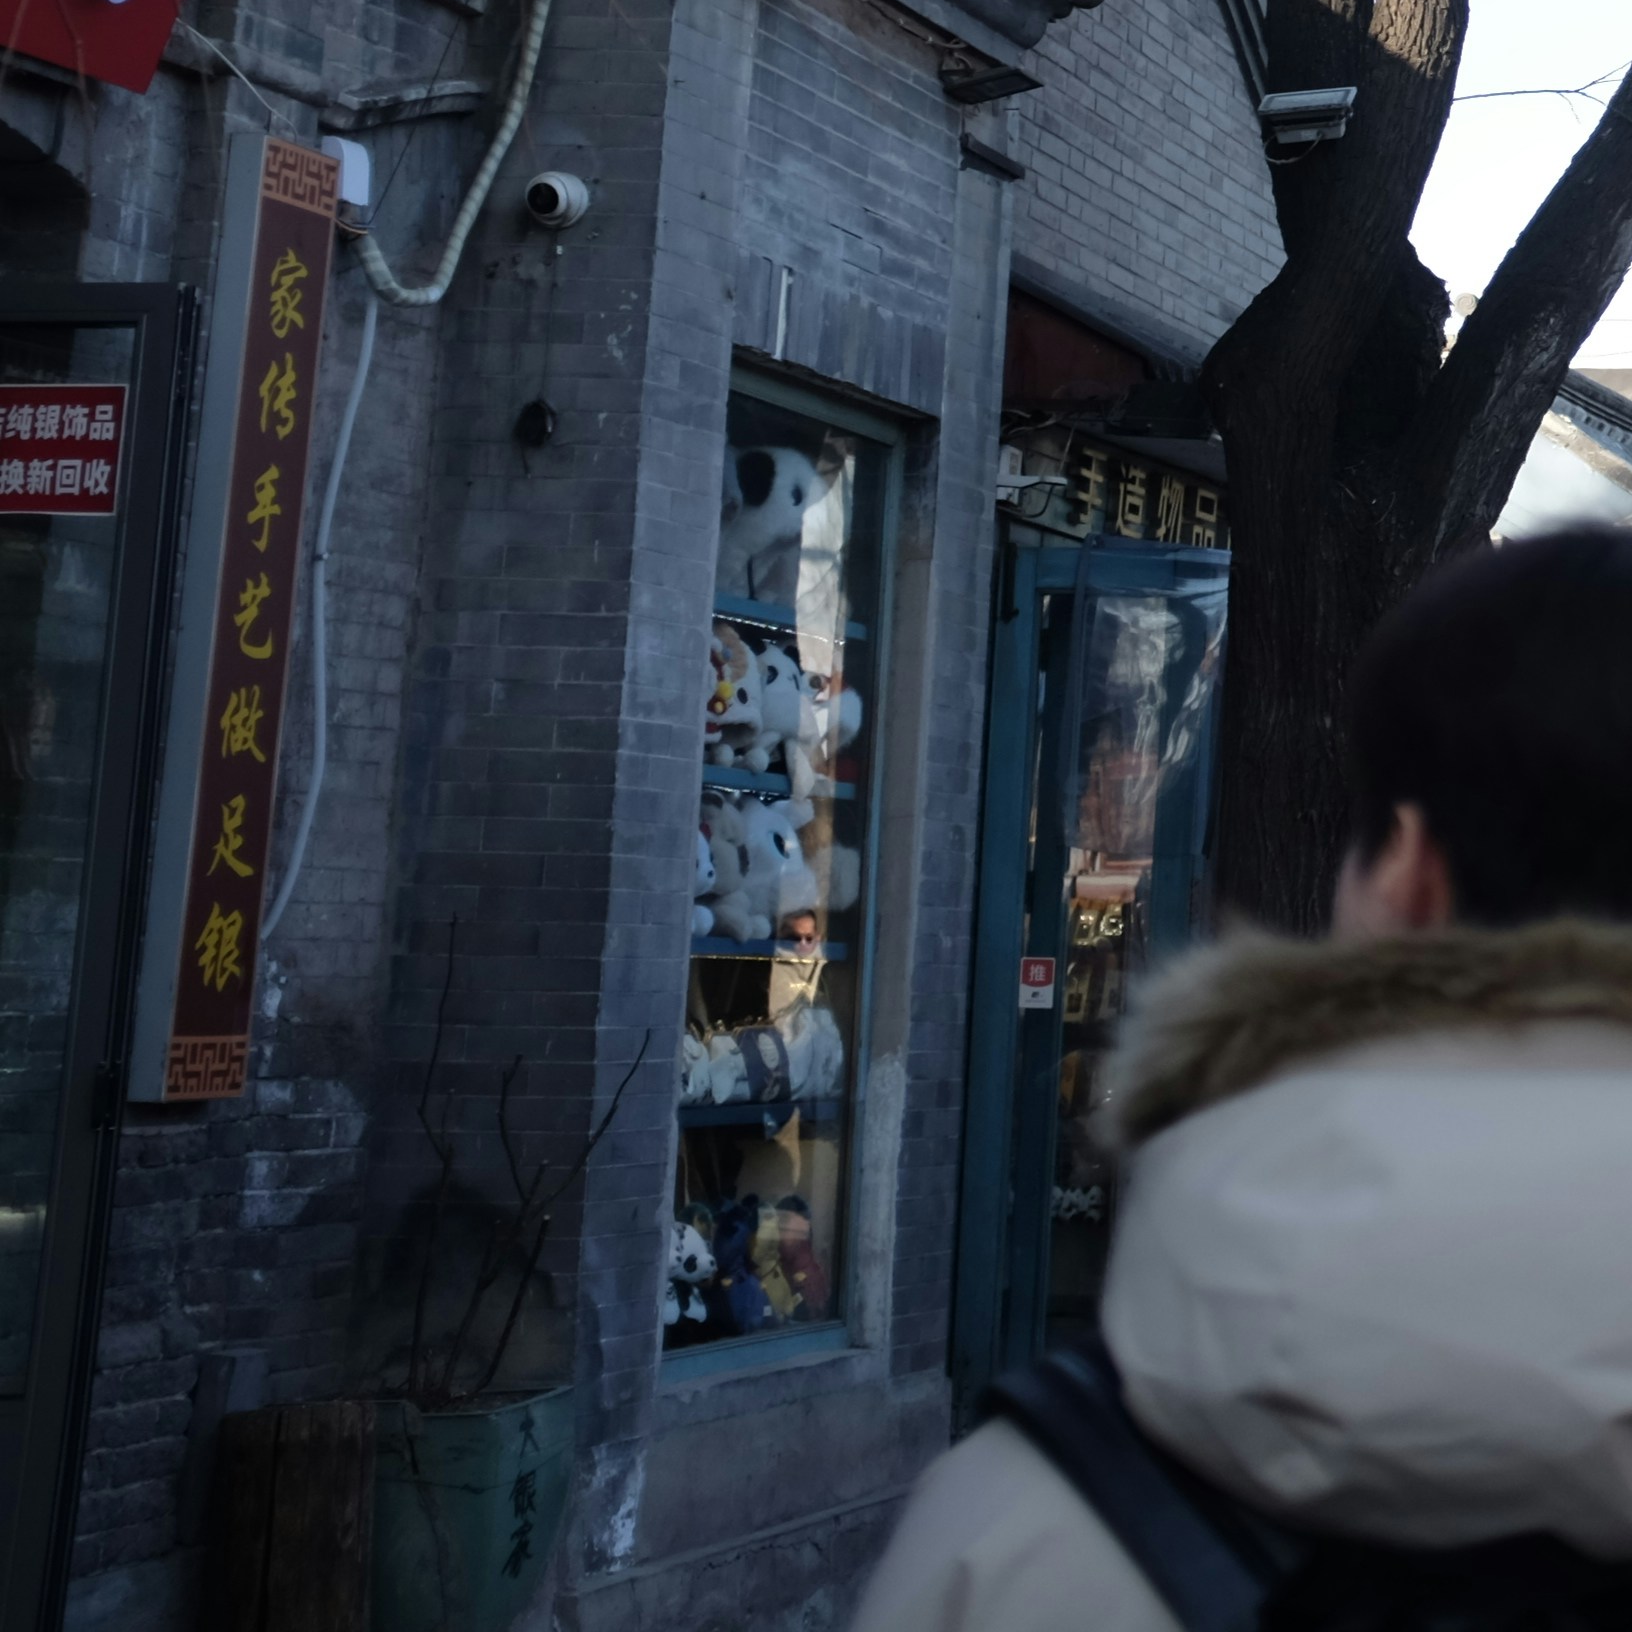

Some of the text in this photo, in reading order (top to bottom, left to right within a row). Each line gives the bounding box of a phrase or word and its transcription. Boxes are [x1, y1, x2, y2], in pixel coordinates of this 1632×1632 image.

[195, 247, 309, 993] 家传手艺做足银
[1029, 964, 1047, 982] 推
